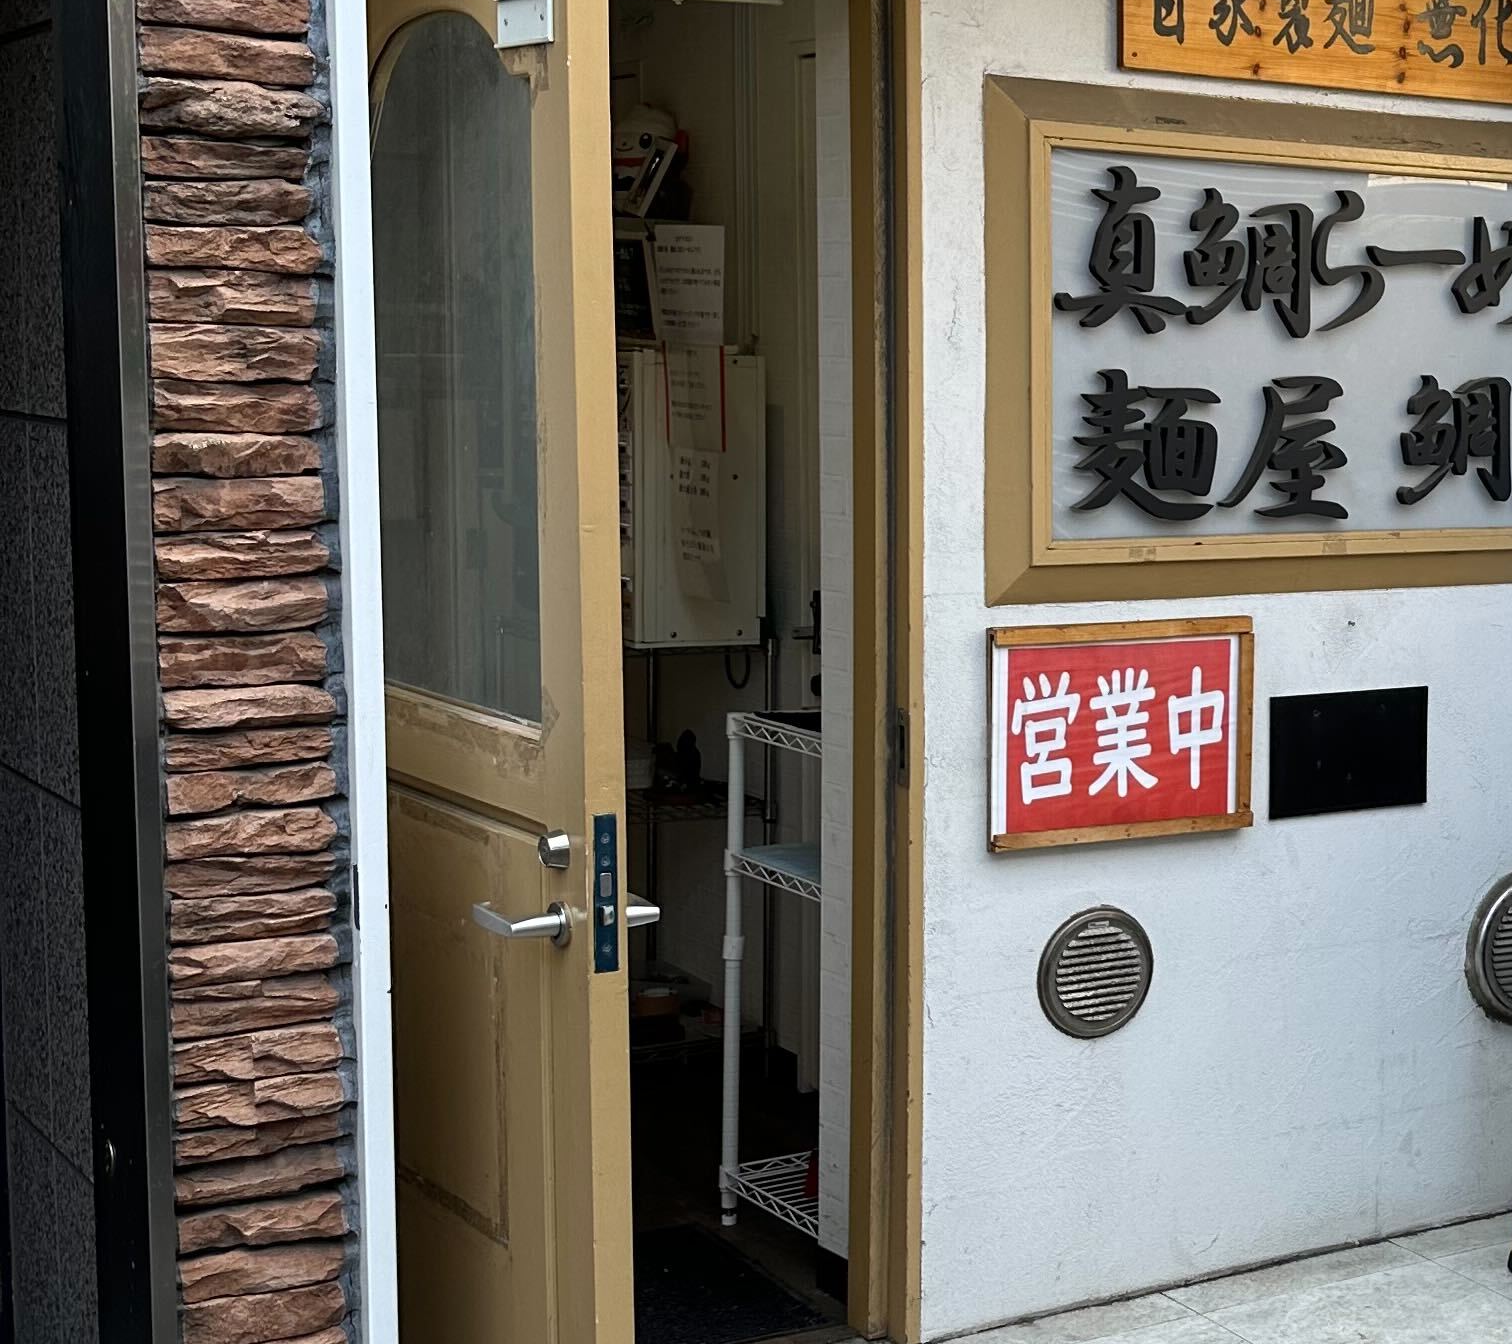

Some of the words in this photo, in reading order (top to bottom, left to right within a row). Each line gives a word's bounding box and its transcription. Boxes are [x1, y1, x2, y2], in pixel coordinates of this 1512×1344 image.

[1069, 368, 1349, 521] 麺屋
[1011, 665, 1225, 805] 営業中
